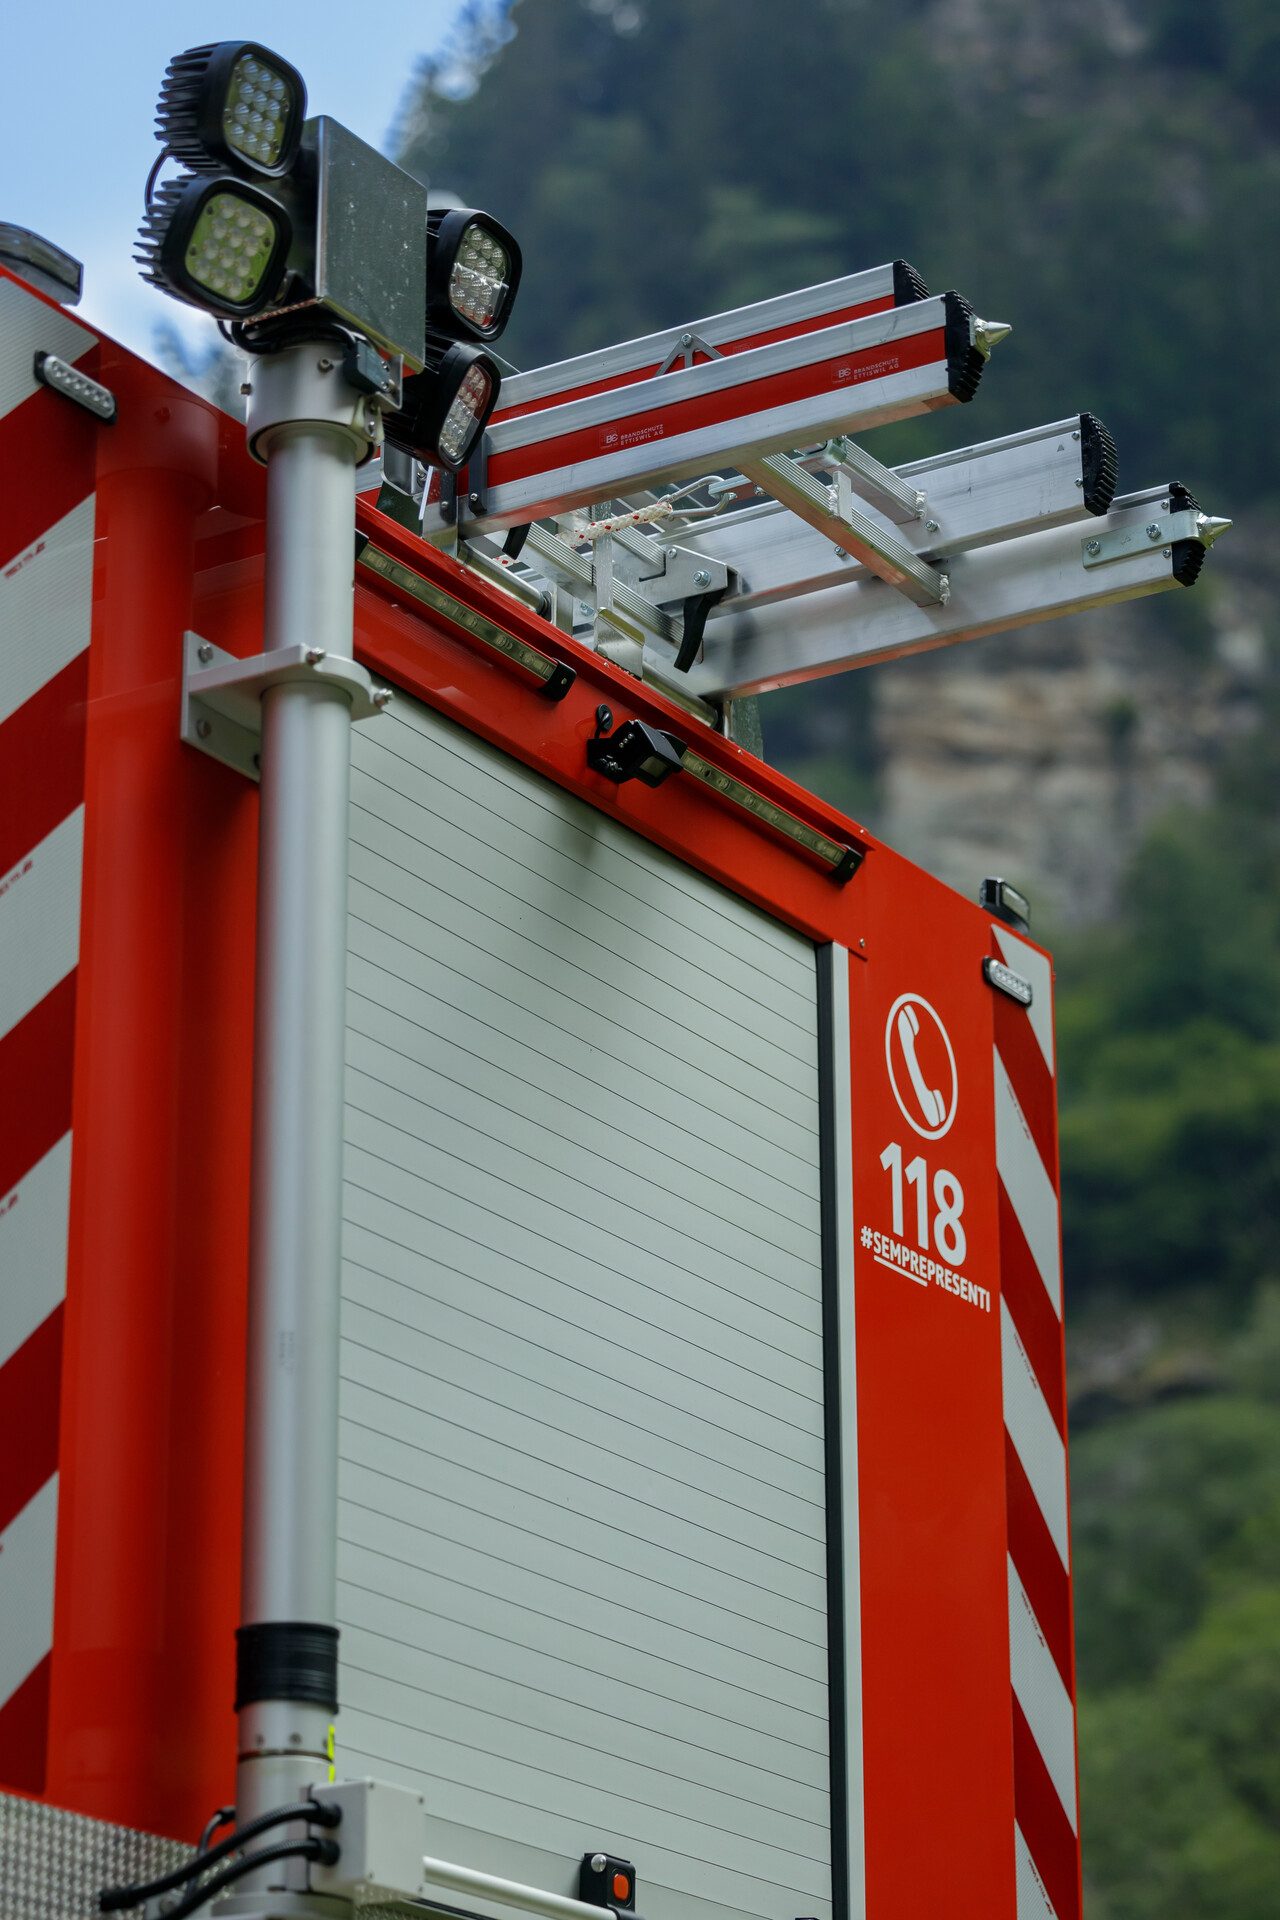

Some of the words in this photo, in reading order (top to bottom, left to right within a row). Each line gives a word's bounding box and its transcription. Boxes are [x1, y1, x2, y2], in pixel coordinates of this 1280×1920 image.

[853, 357, 899, 374] BRANDSCHUTZ
[853, 367, 886, 380] ETTISWIL
[620, 424, 664, 440] BRANDSCHUTZ
[620, 433, 651, 446] ETTISWIL
[879, 1141, 967, 1267] 118
[860, 1225, 991, 1313] #SEMPREPRESENTI
